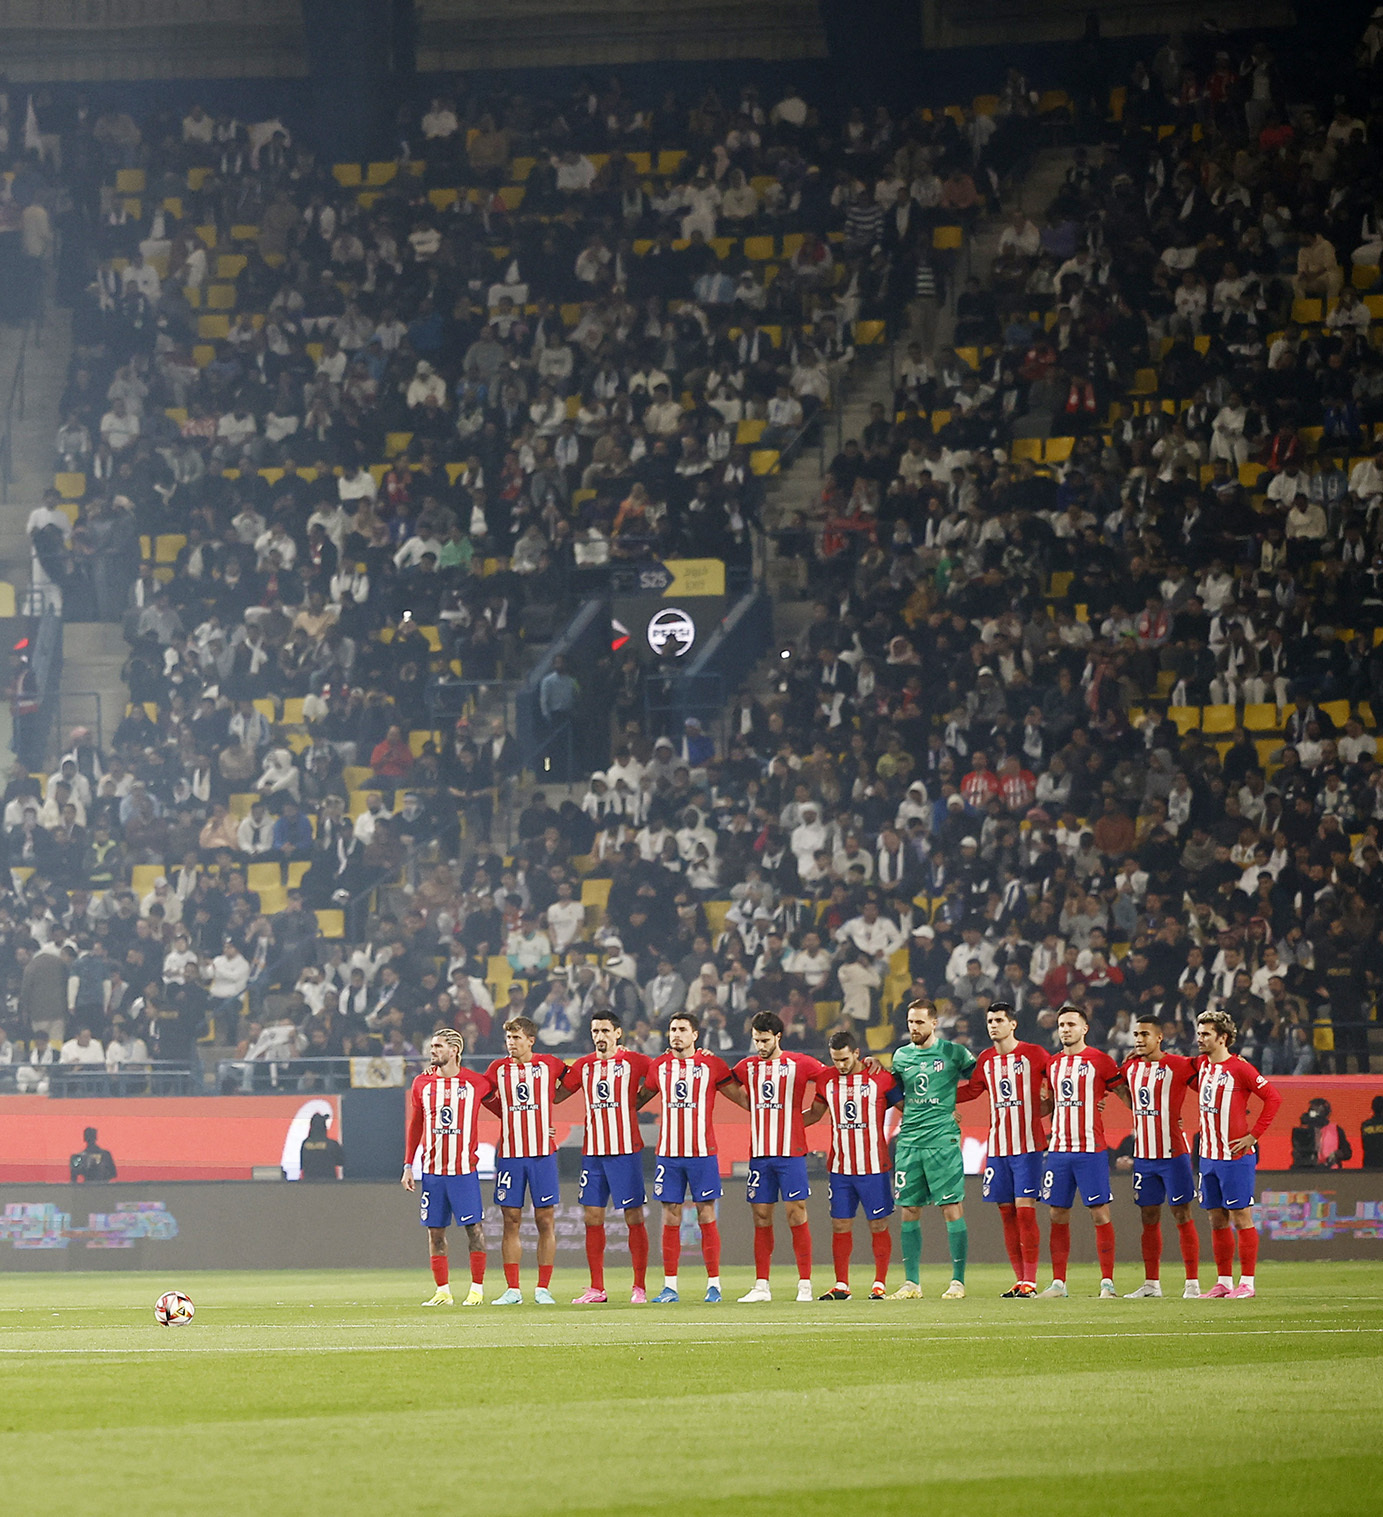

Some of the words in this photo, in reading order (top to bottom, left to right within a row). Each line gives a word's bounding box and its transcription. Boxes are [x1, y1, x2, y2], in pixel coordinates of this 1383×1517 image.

[639, 571, 668, 589] S25
[497, 1170, 512, 1189] 14
[655, 1164, 665, 1183] 2
[747, 1169, 760, 1188] 22
[894, 1170, 907, 1188] 13
[1044, 1170, 1054, 1188] 8
[420, 1191, 430, 1209] 5
